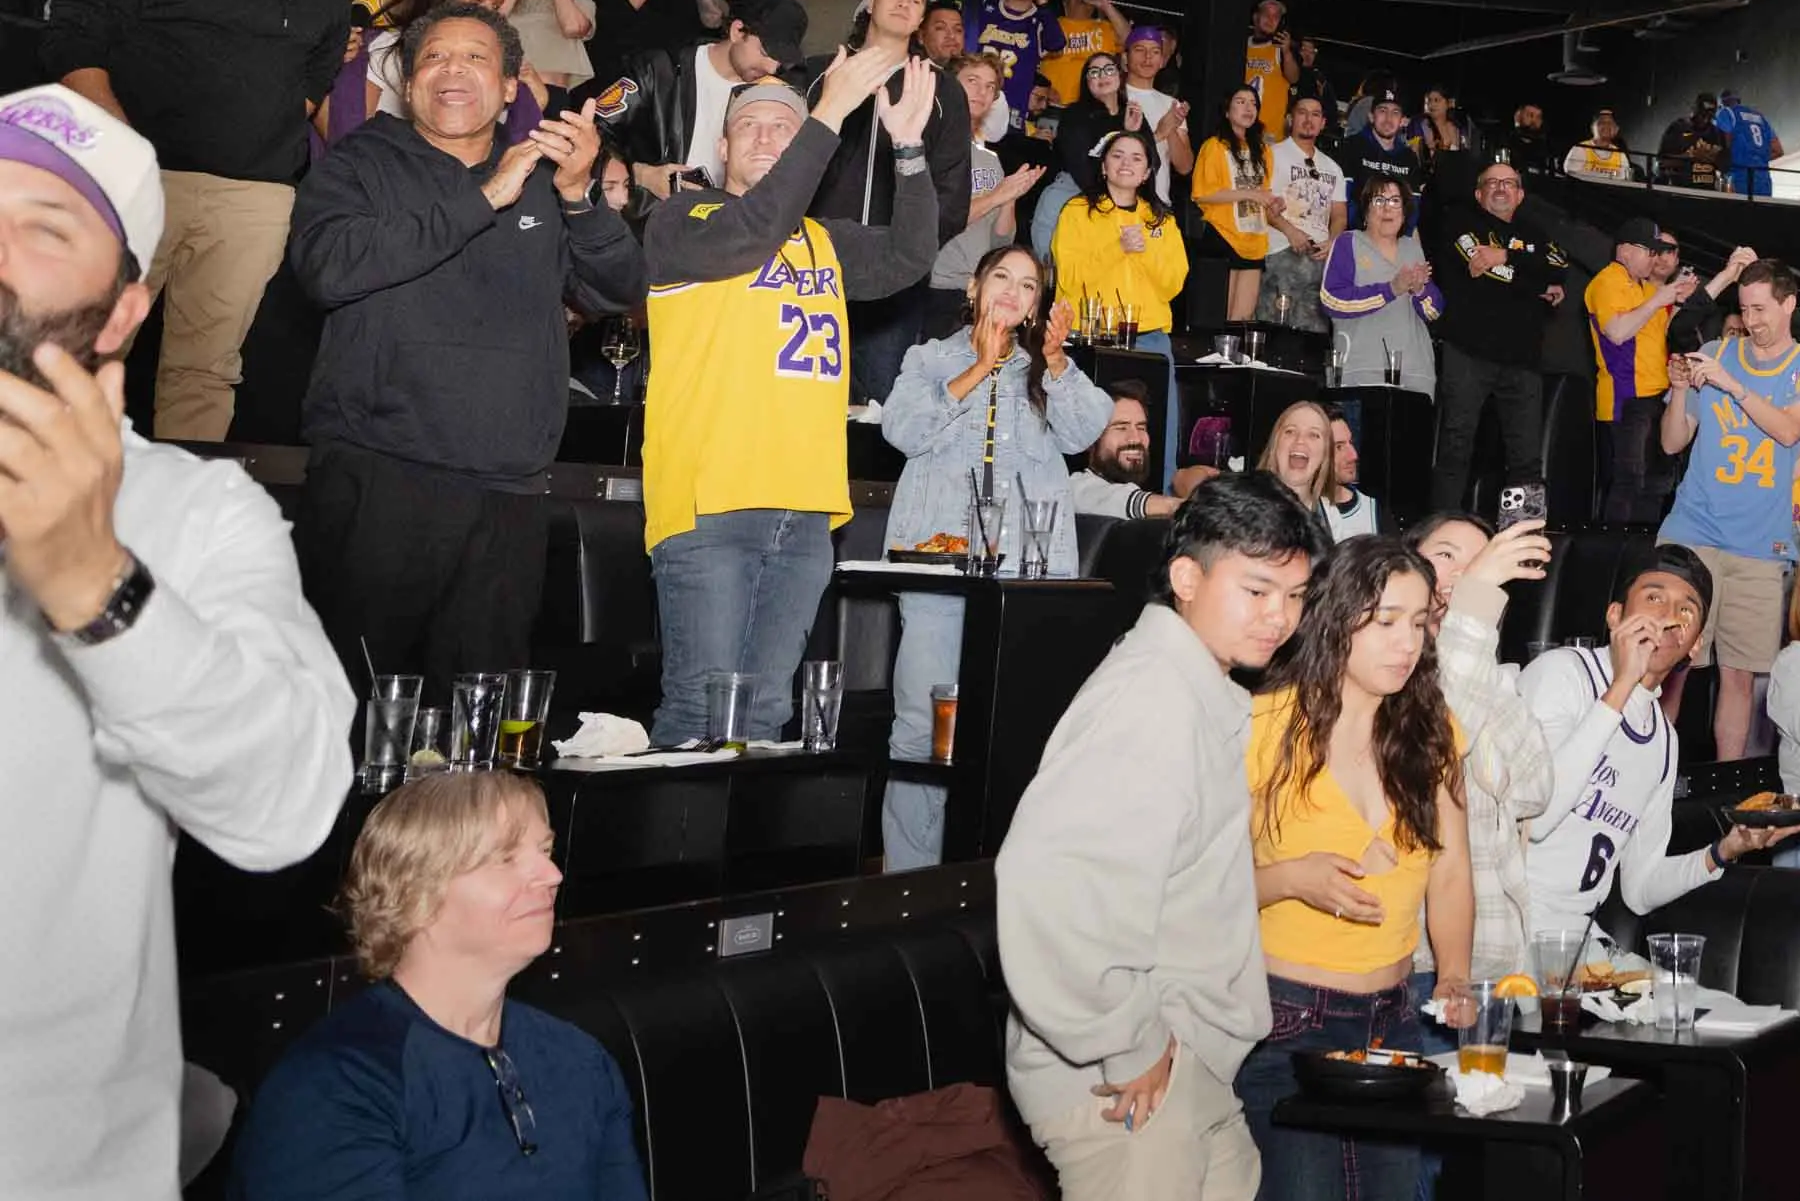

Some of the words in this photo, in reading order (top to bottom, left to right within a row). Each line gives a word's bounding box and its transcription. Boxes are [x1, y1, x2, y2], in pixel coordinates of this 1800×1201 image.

[777, 302, 843, 379] 23
[1714, 433, 1777, 489] 34
[1578, 831, 1616, 893] 6
